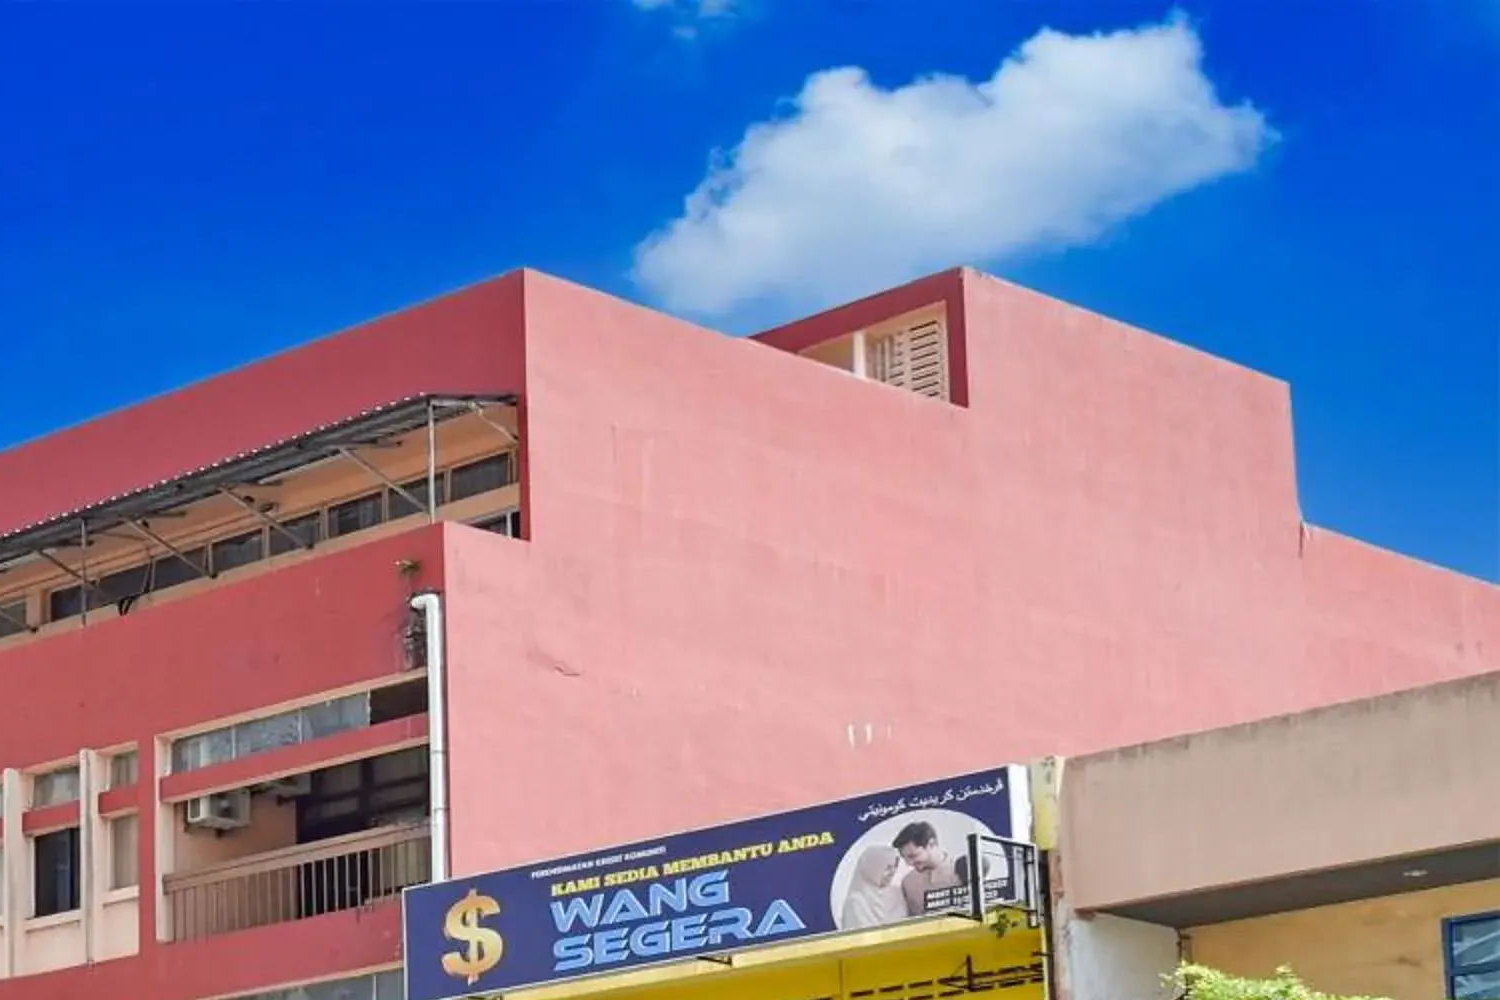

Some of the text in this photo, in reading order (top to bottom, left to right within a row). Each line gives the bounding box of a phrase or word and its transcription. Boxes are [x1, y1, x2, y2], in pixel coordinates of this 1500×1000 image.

[552, 831, 835, 896] KAMI SEDIA MEMBANTU ANDA
[550, 869, 730, 932] WANG
[553, 899, 807, 971] SEGERA
